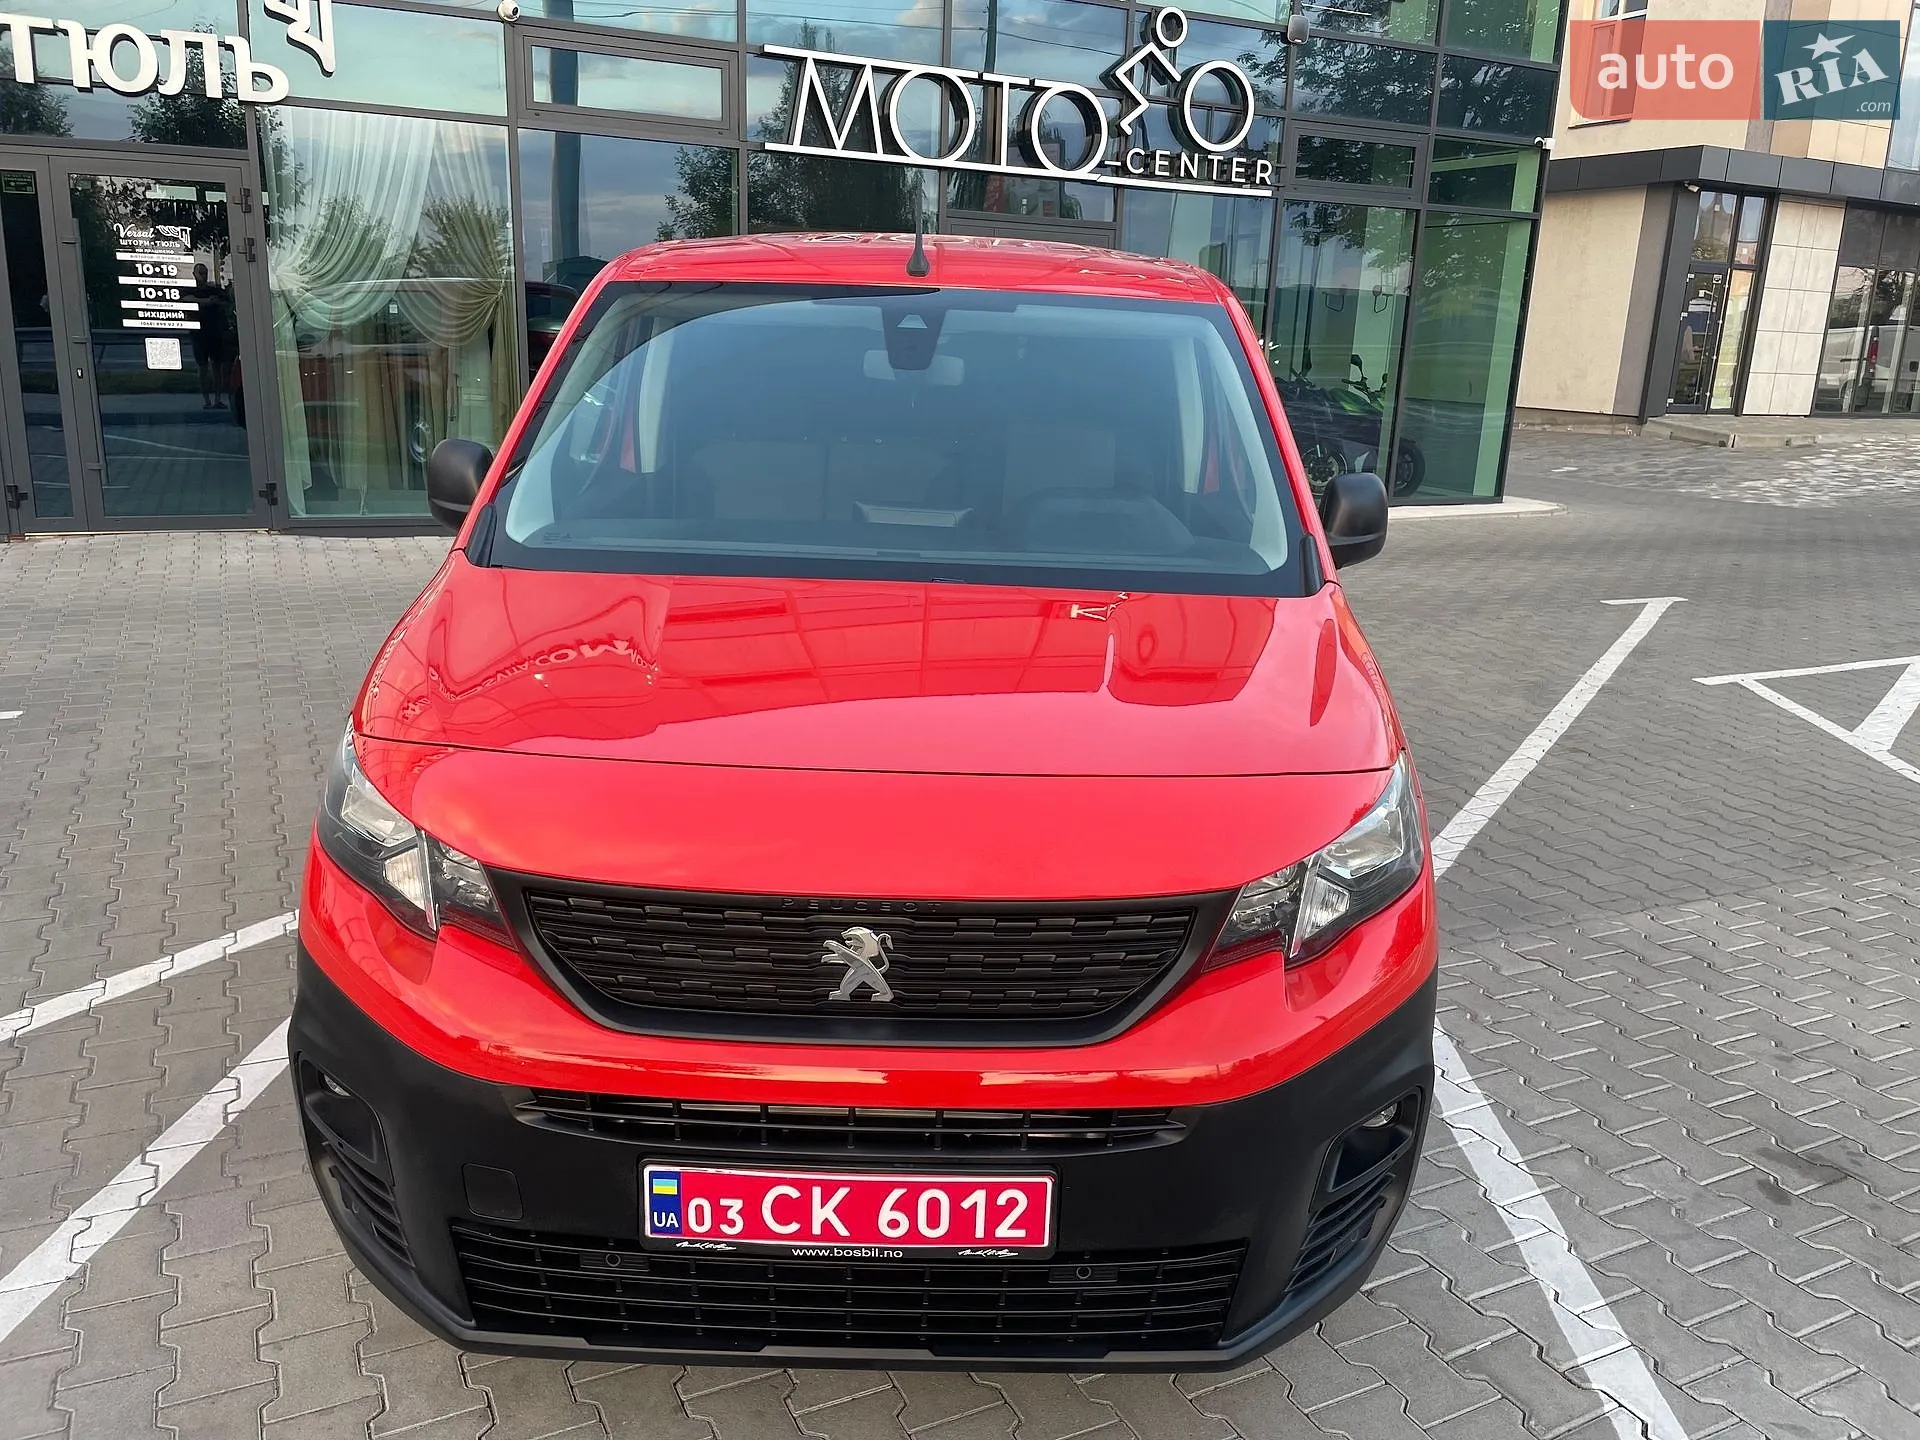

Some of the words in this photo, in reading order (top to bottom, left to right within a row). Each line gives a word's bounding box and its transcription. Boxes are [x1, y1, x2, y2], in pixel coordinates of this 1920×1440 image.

[0, 13, 290, 103] ТЮЛЬ
[1125, 147, 1273, 186] CENTER
[113, 223, 155, 238] Versal
[653, 1211, 679, 1229] UA
[686, 1197, 744, 1235] 03
[761, 1185, 851, 1237] CK
[877, 1187, 1029, 1239] 6012
[791, 1245, 904, 1259] www.bosbil.no
